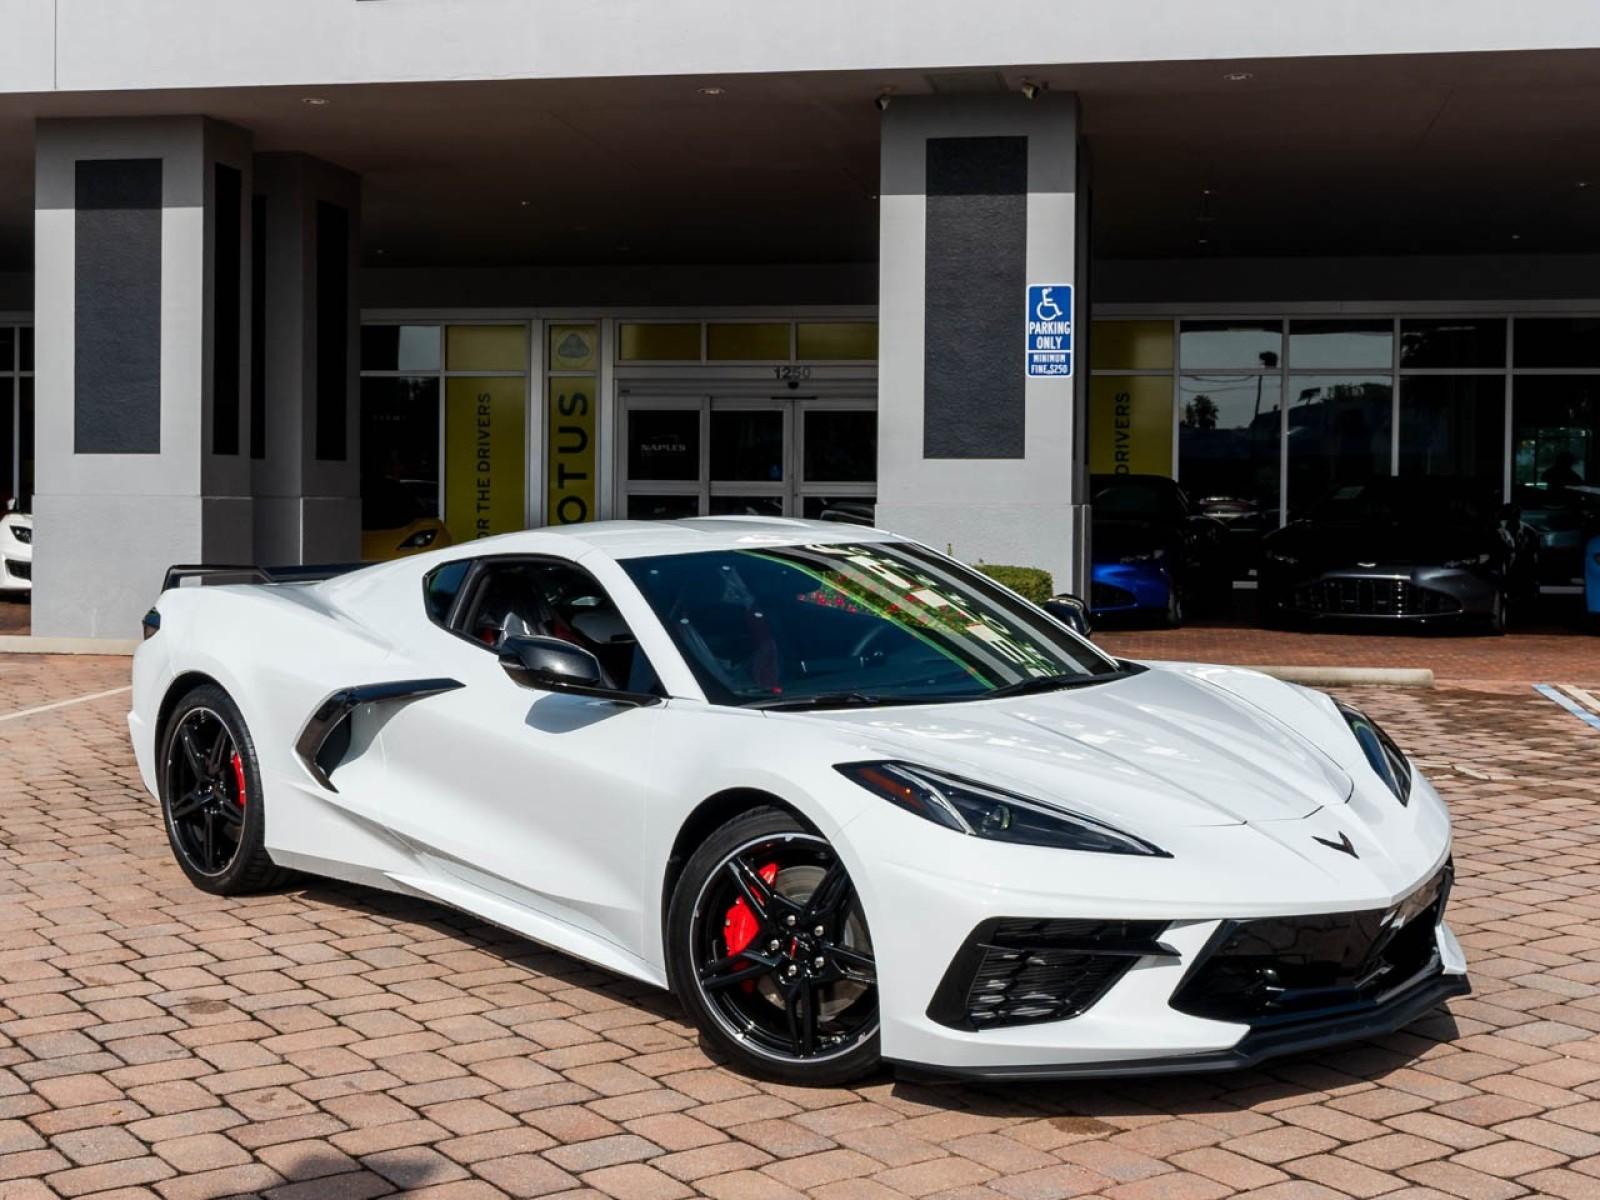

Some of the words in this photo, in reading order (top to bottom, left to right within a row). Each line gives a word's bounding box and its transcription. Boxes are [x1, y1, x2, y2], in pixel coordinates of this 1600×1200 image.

[1029, 321, 1071, 335] PARKING
[1036, 336, 1063, 350] ONLY
[1033, 354, 1066, 363] MINIMUM
[774, 365, 812, 380] 1250
[1031, 364, 1048, 374] FINE
[477, 391, 491, 473] DRIVERS
[1114, 391, 1131, 476] DRIVERS
[640, 443, 687, 452] NAPLES
[556, 391, 589, 525] OTUS
[476, 478, 491, 514] THE
